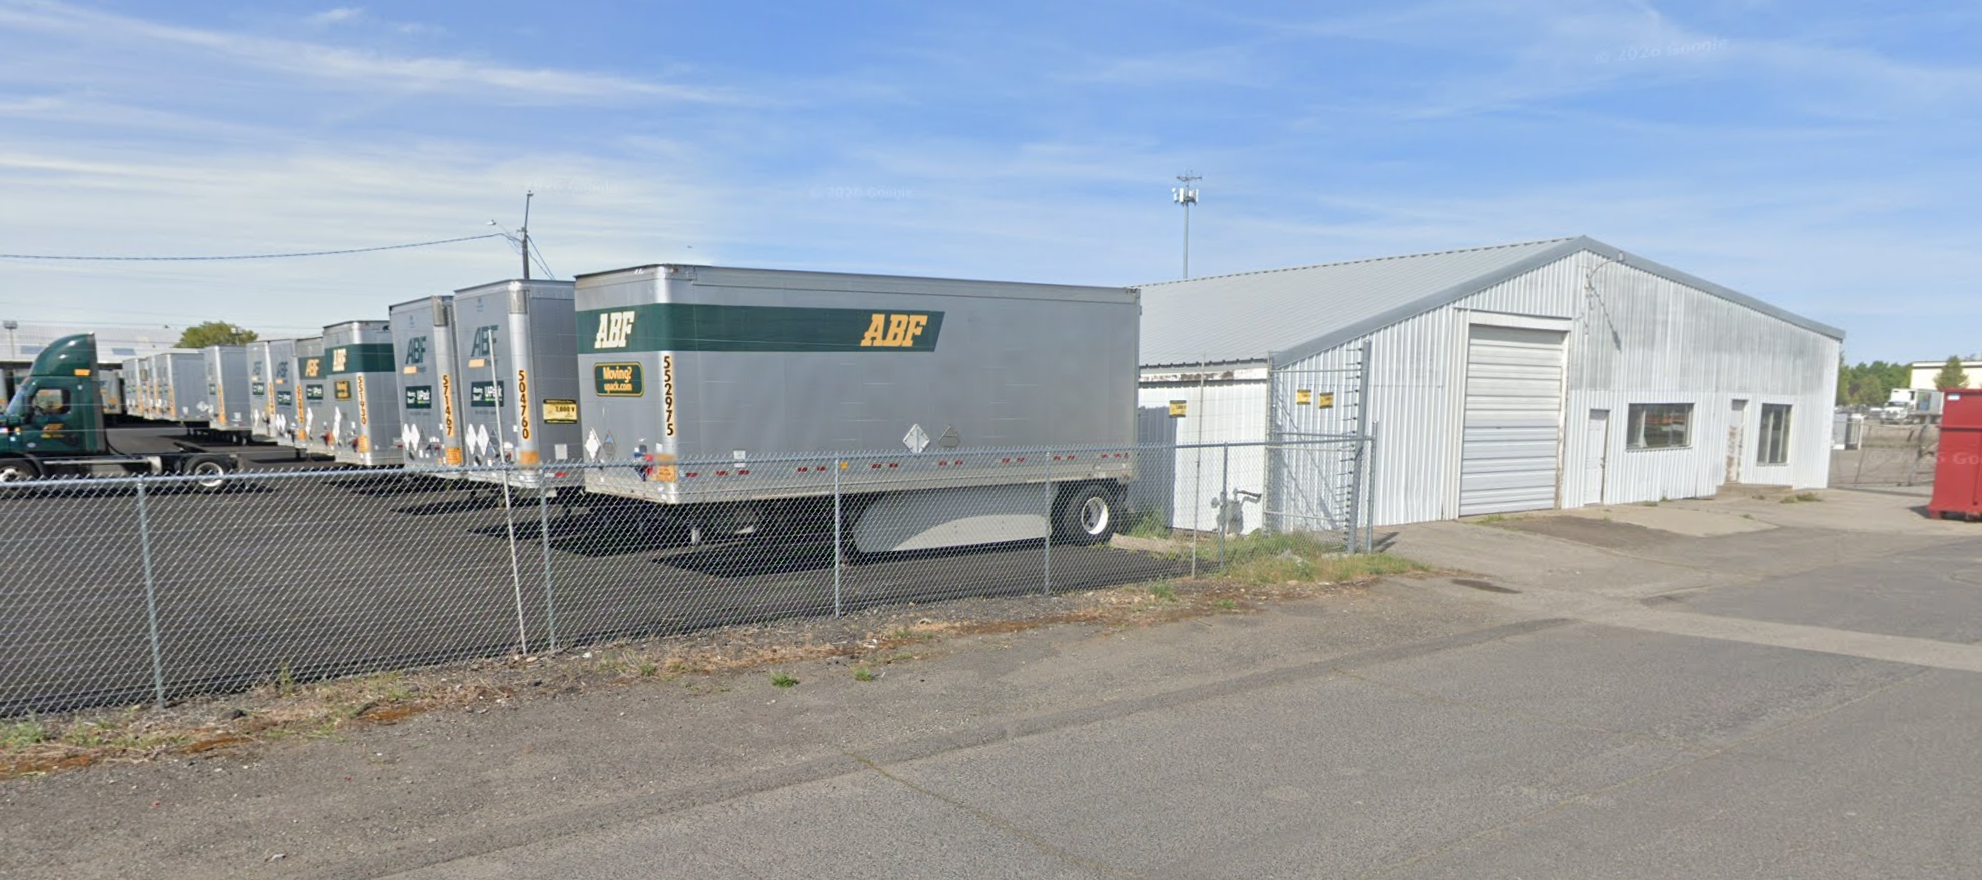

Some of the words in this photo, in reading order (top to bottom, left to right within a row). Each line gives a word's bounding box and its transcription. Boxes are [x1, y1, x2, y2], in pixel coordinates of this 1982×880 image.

[594, 311, 635, 348] ABF
[860, 313, 928, 347] ABF
[405, 336, 427, 364] ABF
[603, 366, 632, 383] Moving?
[442, 375, 453, 436] 571467
[518, 369, 530, 440] 504760
[663, 355, 674, 436] 552975
